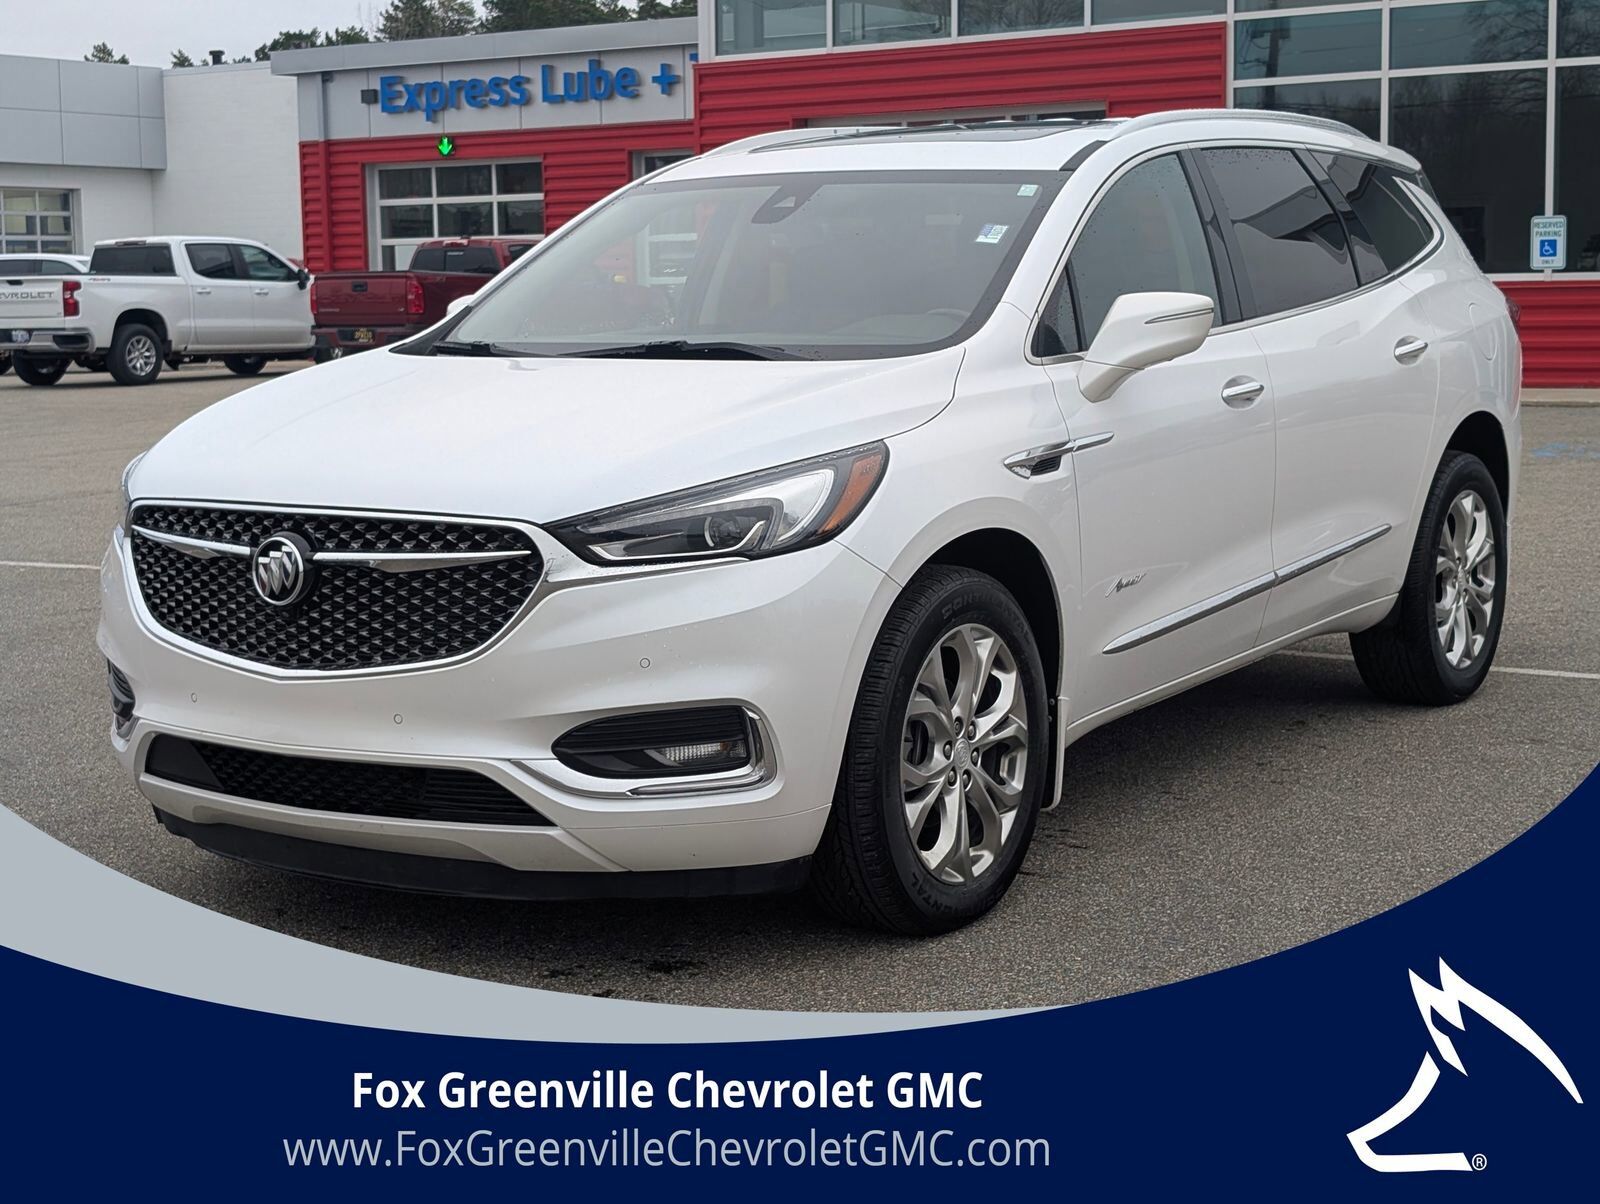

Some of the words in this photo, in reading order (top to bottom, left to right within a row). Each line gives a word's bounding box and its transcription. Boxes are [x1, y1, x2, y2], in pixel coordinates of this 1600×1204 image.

[380, 75, 530, 122] Express
[541, 58, 640, 103] Lube
[1533, 221, 1564, 229] RESERVED
[1535, 229, 1562, 237] PARKING
